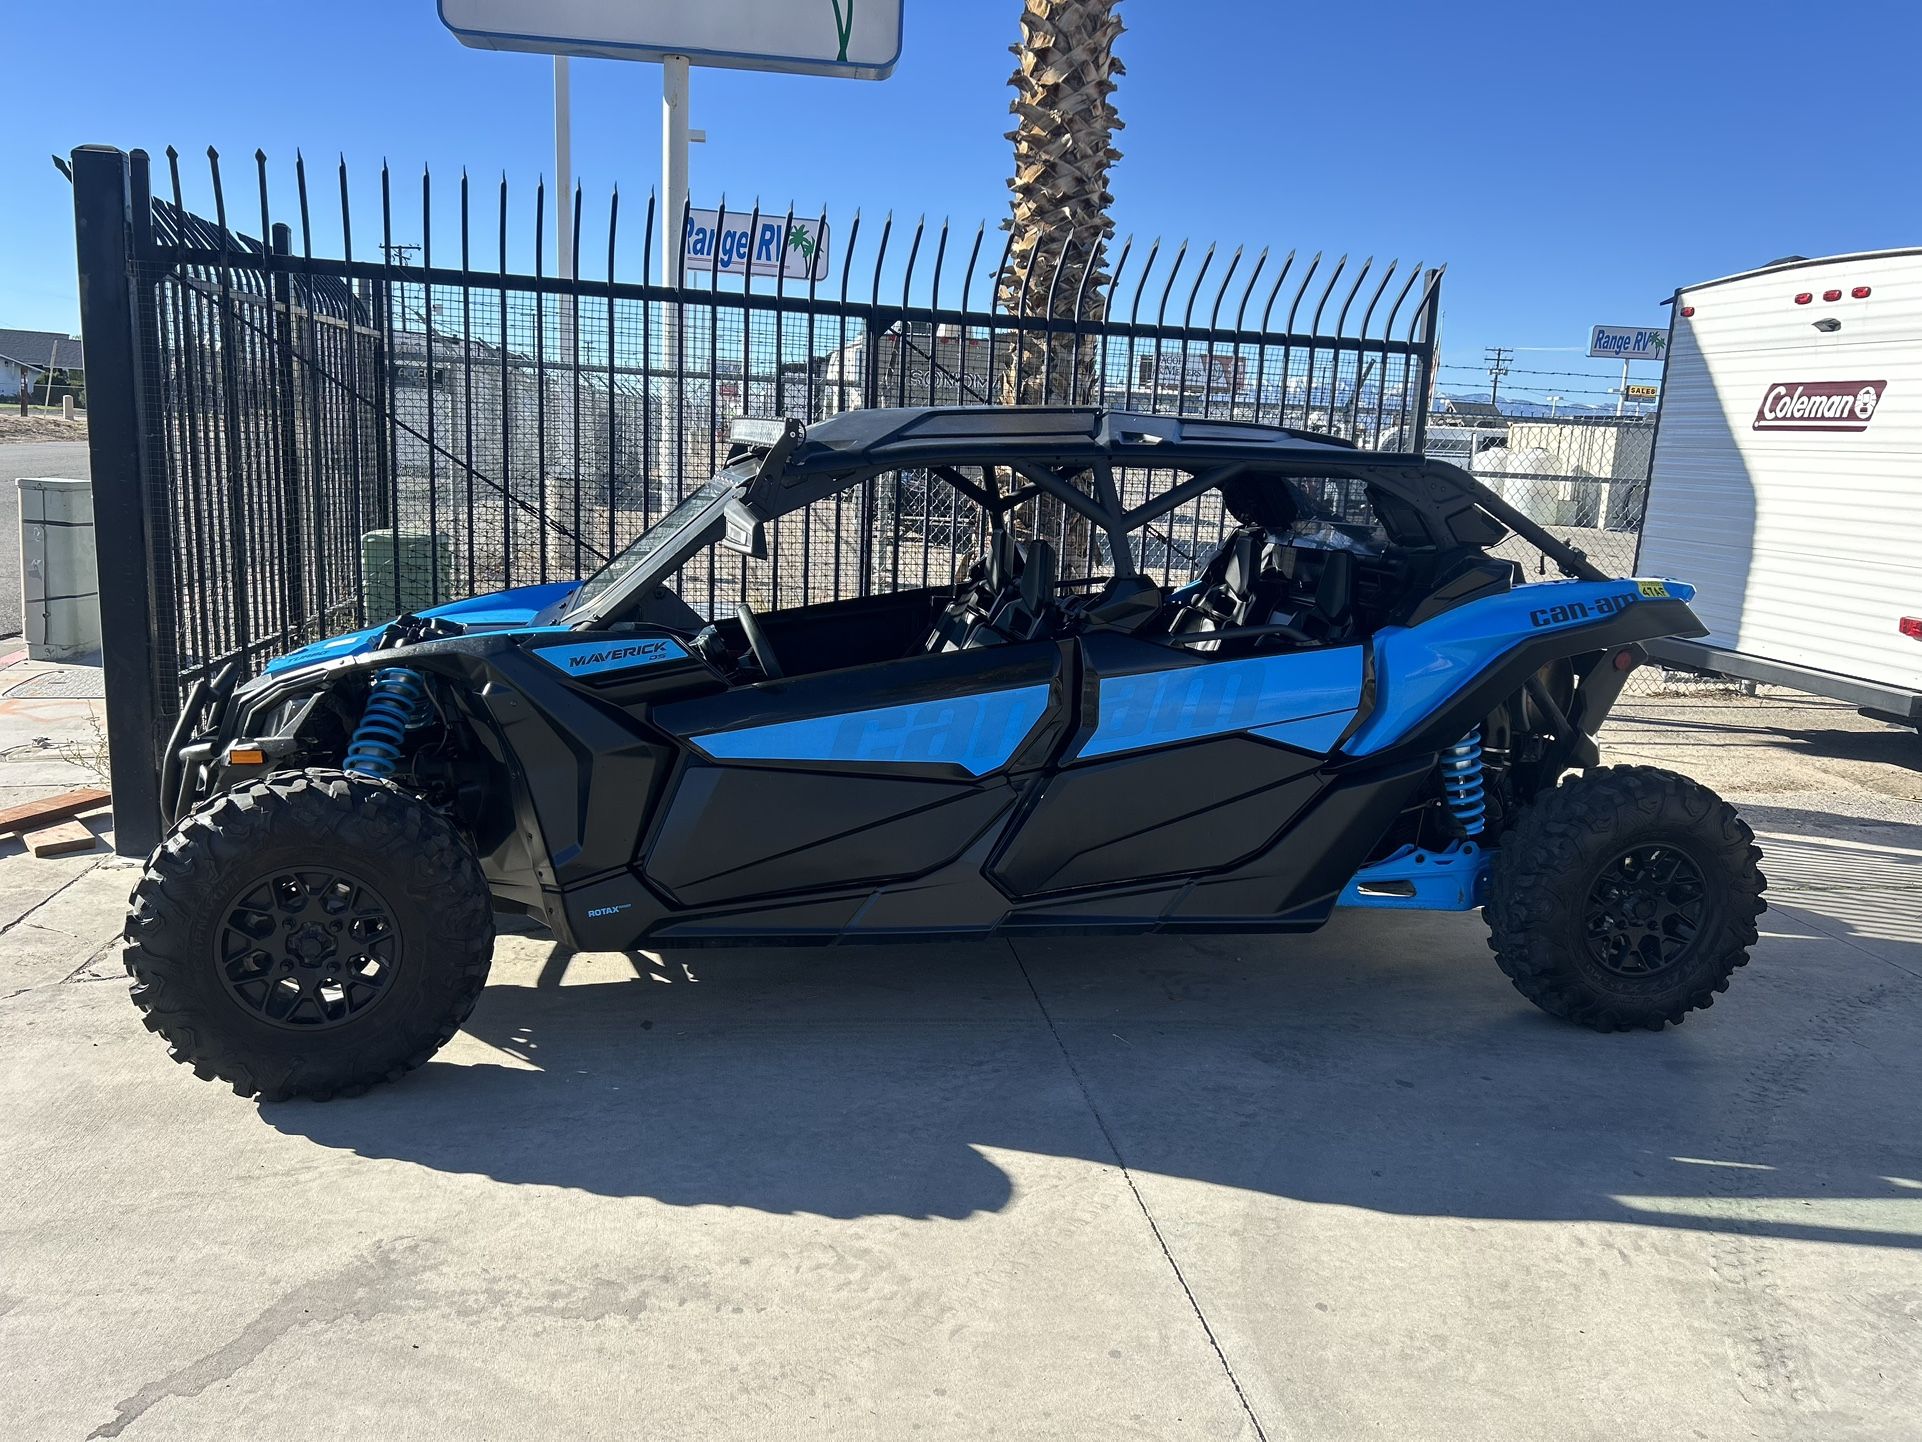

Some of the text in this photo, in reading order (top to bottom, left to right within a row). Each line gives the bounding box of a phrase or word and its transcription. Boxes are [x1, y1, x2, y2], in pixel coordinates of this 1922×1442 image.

[686, 216, 749, 268] Range
[1594, 329, 1651, 356] Range RV
[1165, 364, 1202, 378] MEERS
[1630, 387, 1656, 395] SALES
[1763, 385, 1855, 420] Coleman
[1530, 592, 1638, 628] can-am
[569, 641, 668, 668] MAVERICK
[588, 905, 619, 917] ROTAX
